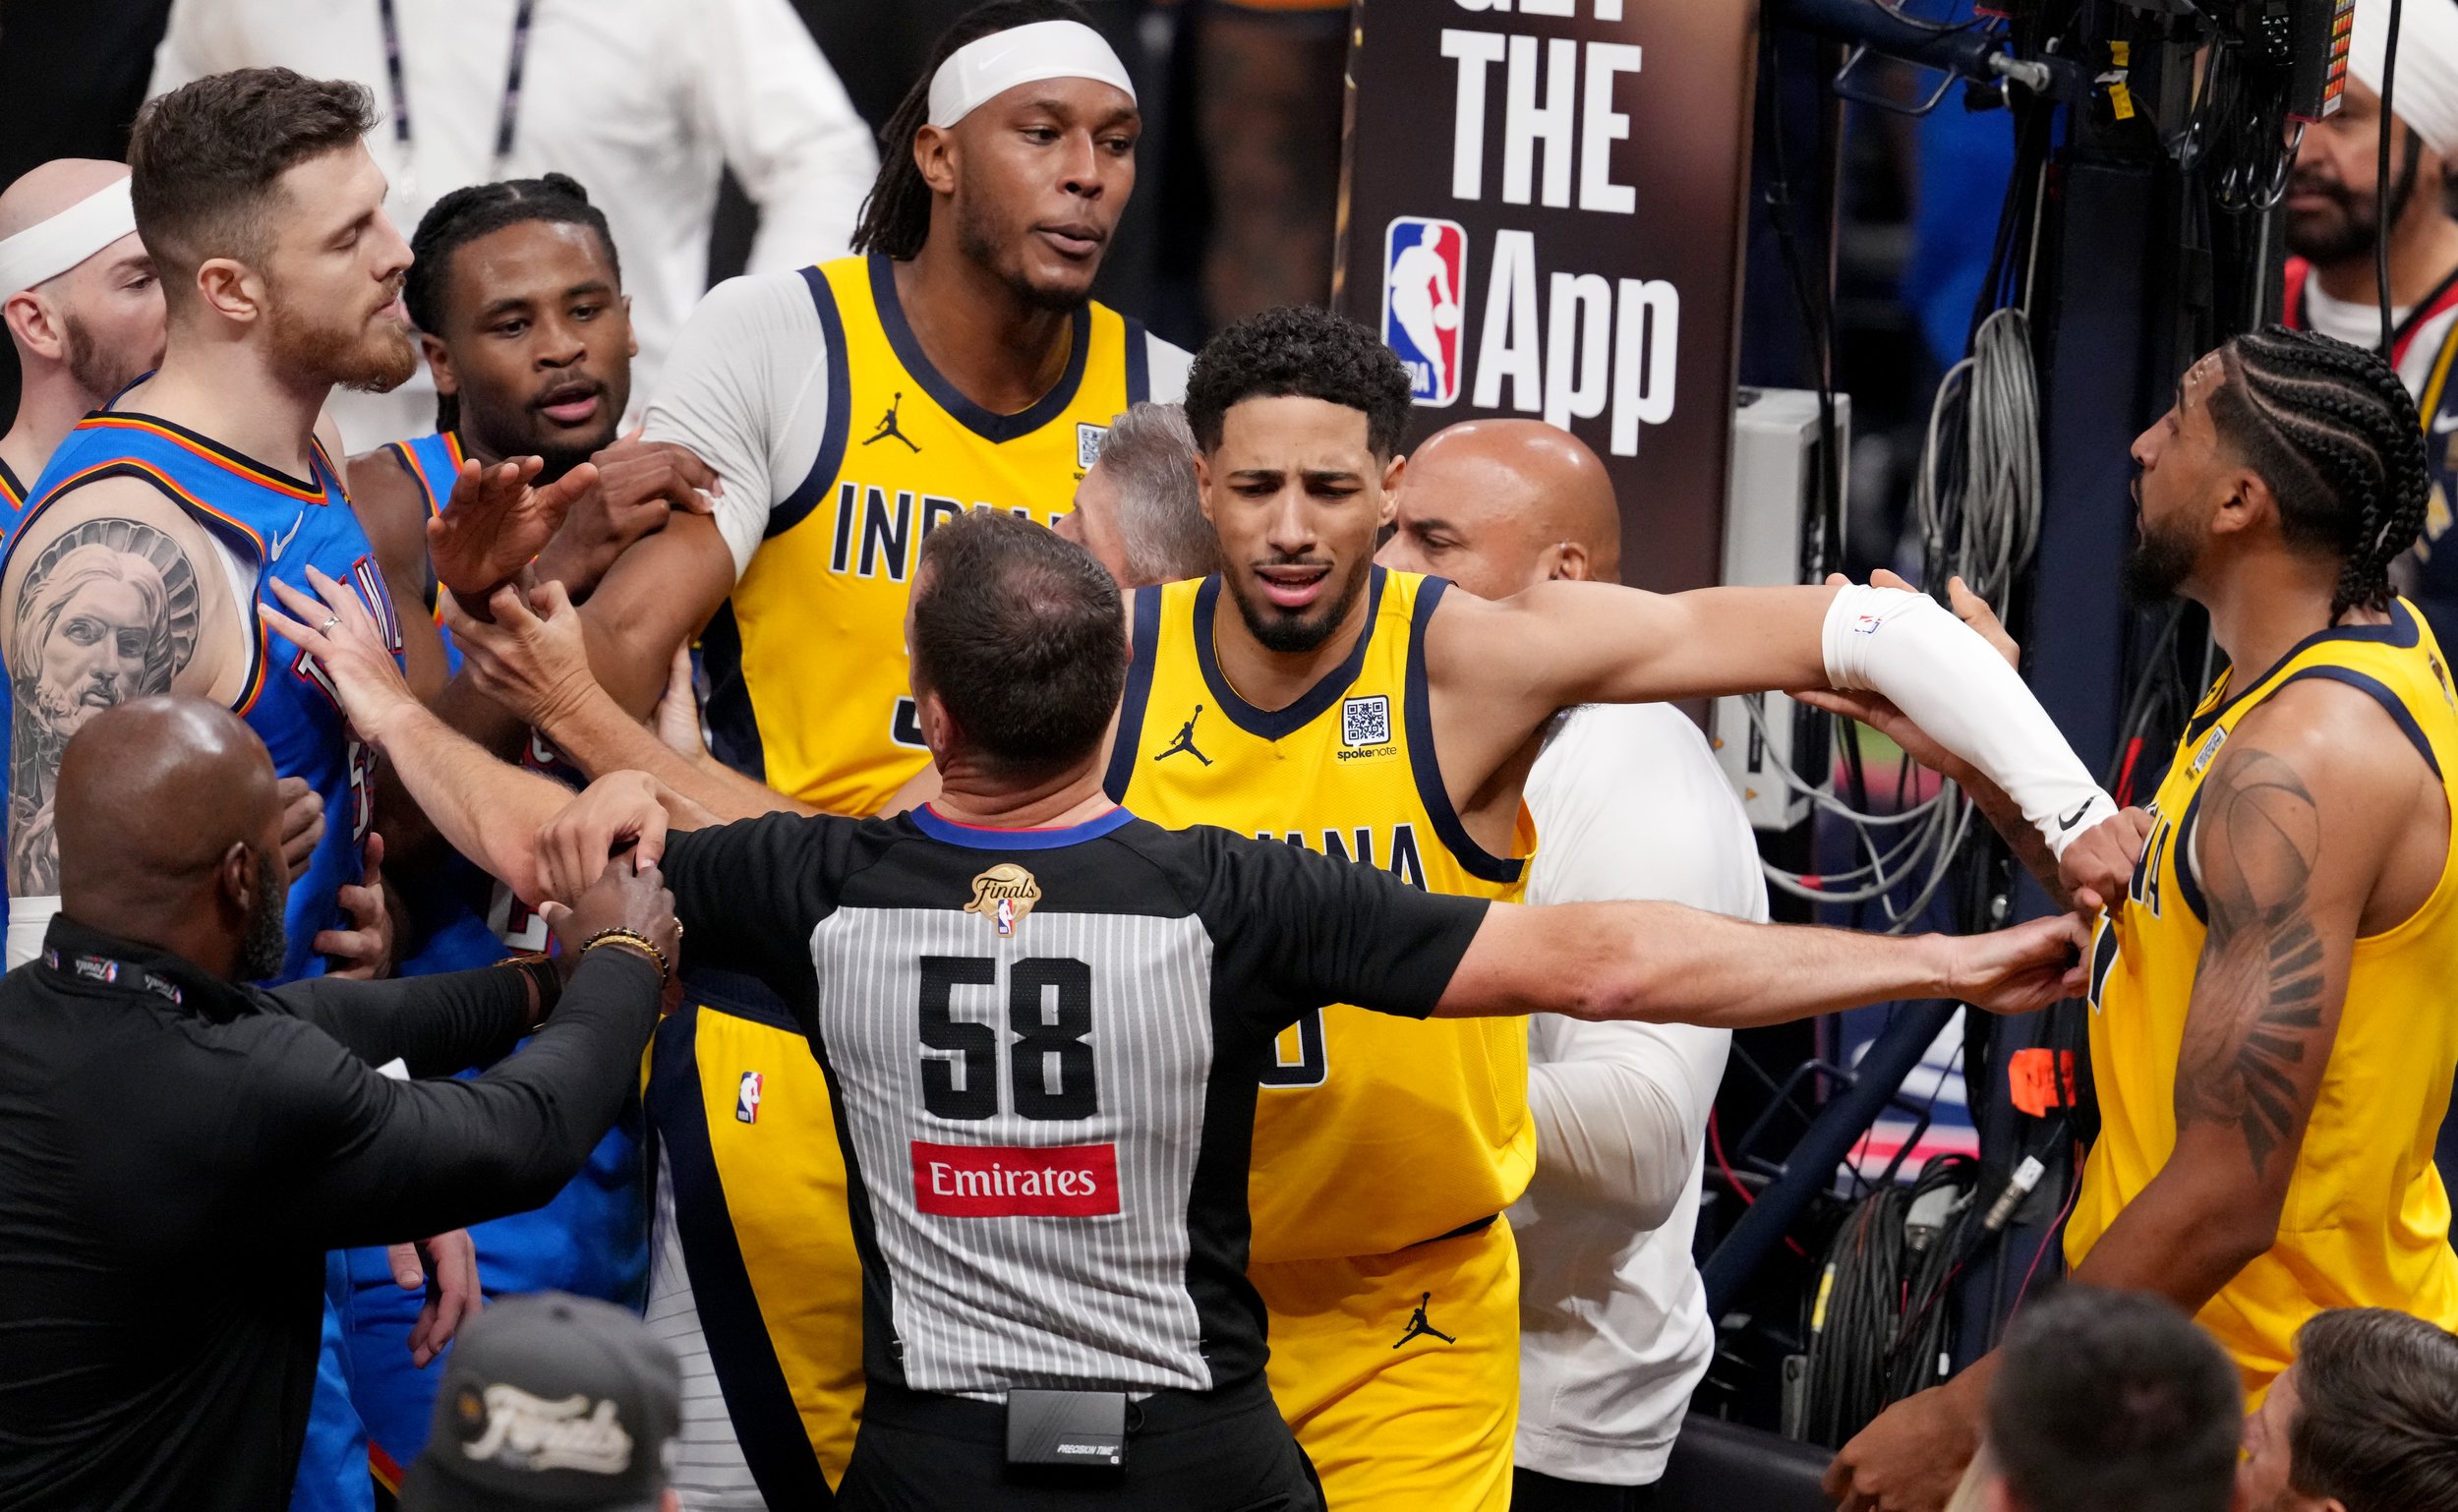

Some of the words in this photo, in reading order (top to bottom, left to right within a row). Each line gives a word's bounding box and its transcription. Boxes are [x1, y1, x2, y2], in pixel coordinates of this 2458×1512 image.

[1440, 29, 1642, 214] THE
[1472, 229, 1679, 456] App
[1337, 747, 1397, 762] spokenote
[967, 877, 1038, 909] Finals
[919, 955, 1098, 1121] 58
[929, 1161, 1096, 1197] Emirates
[1057, 1444, 1096, 1455] PRECISION
